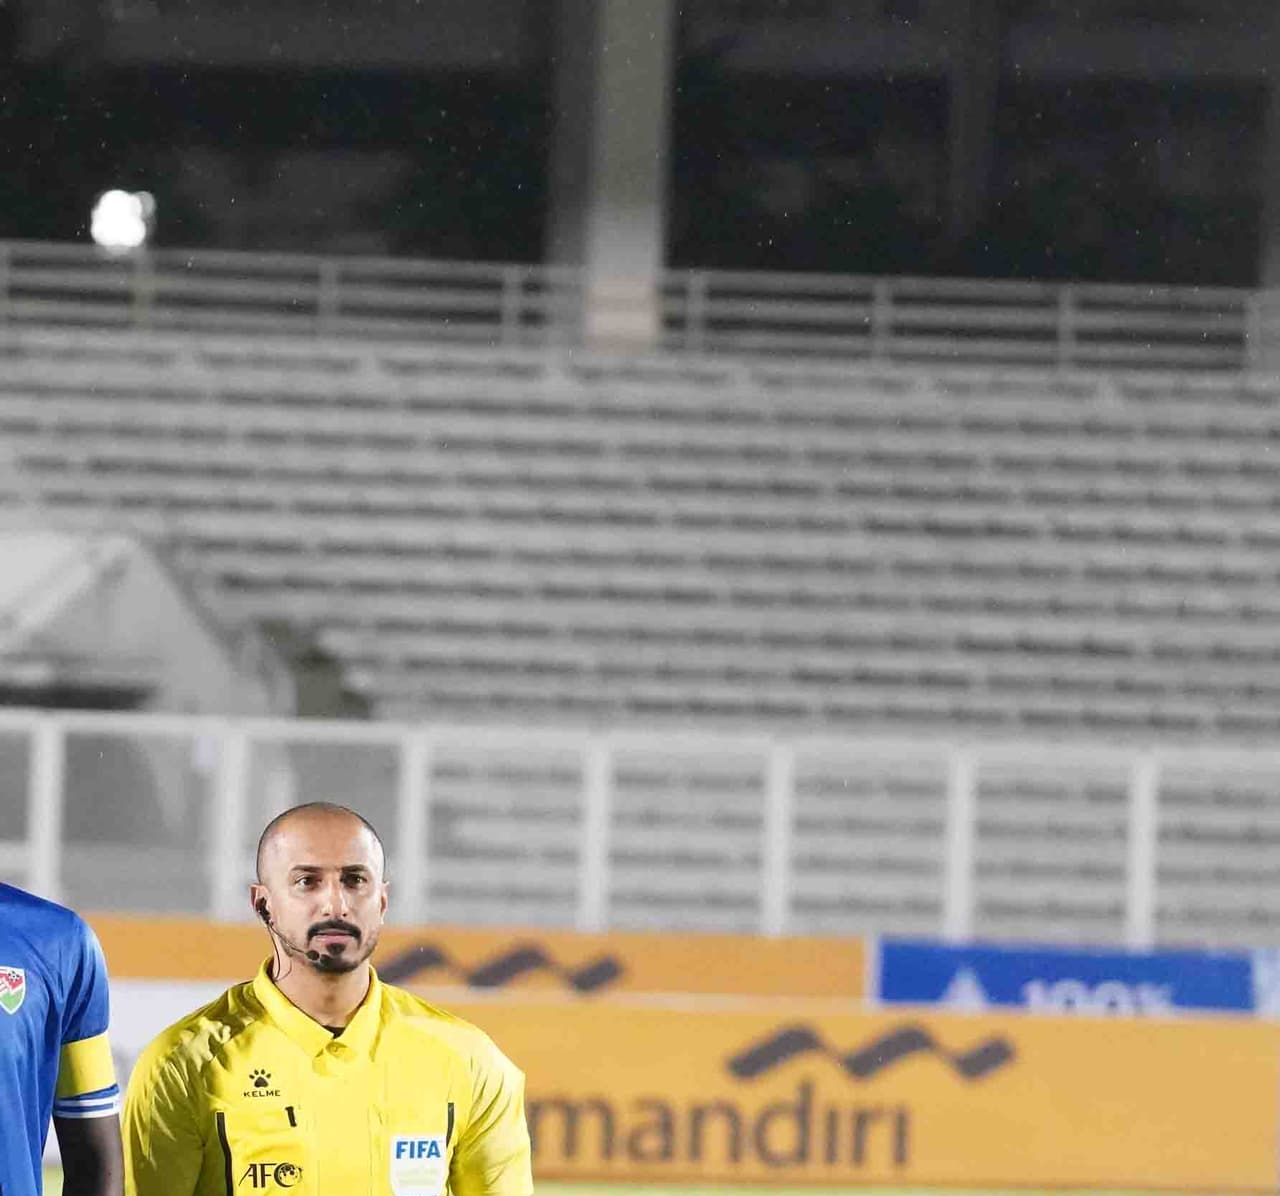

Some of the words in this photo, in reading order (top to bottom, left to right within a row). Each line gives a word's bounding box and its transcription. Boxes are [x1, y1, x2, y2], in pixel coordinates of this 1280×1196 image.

[243, 1090, 281, 1098] KELME
[528, 1080, 910, 1167] mandiri
[396, 1140, 441, 1159] FIFA
